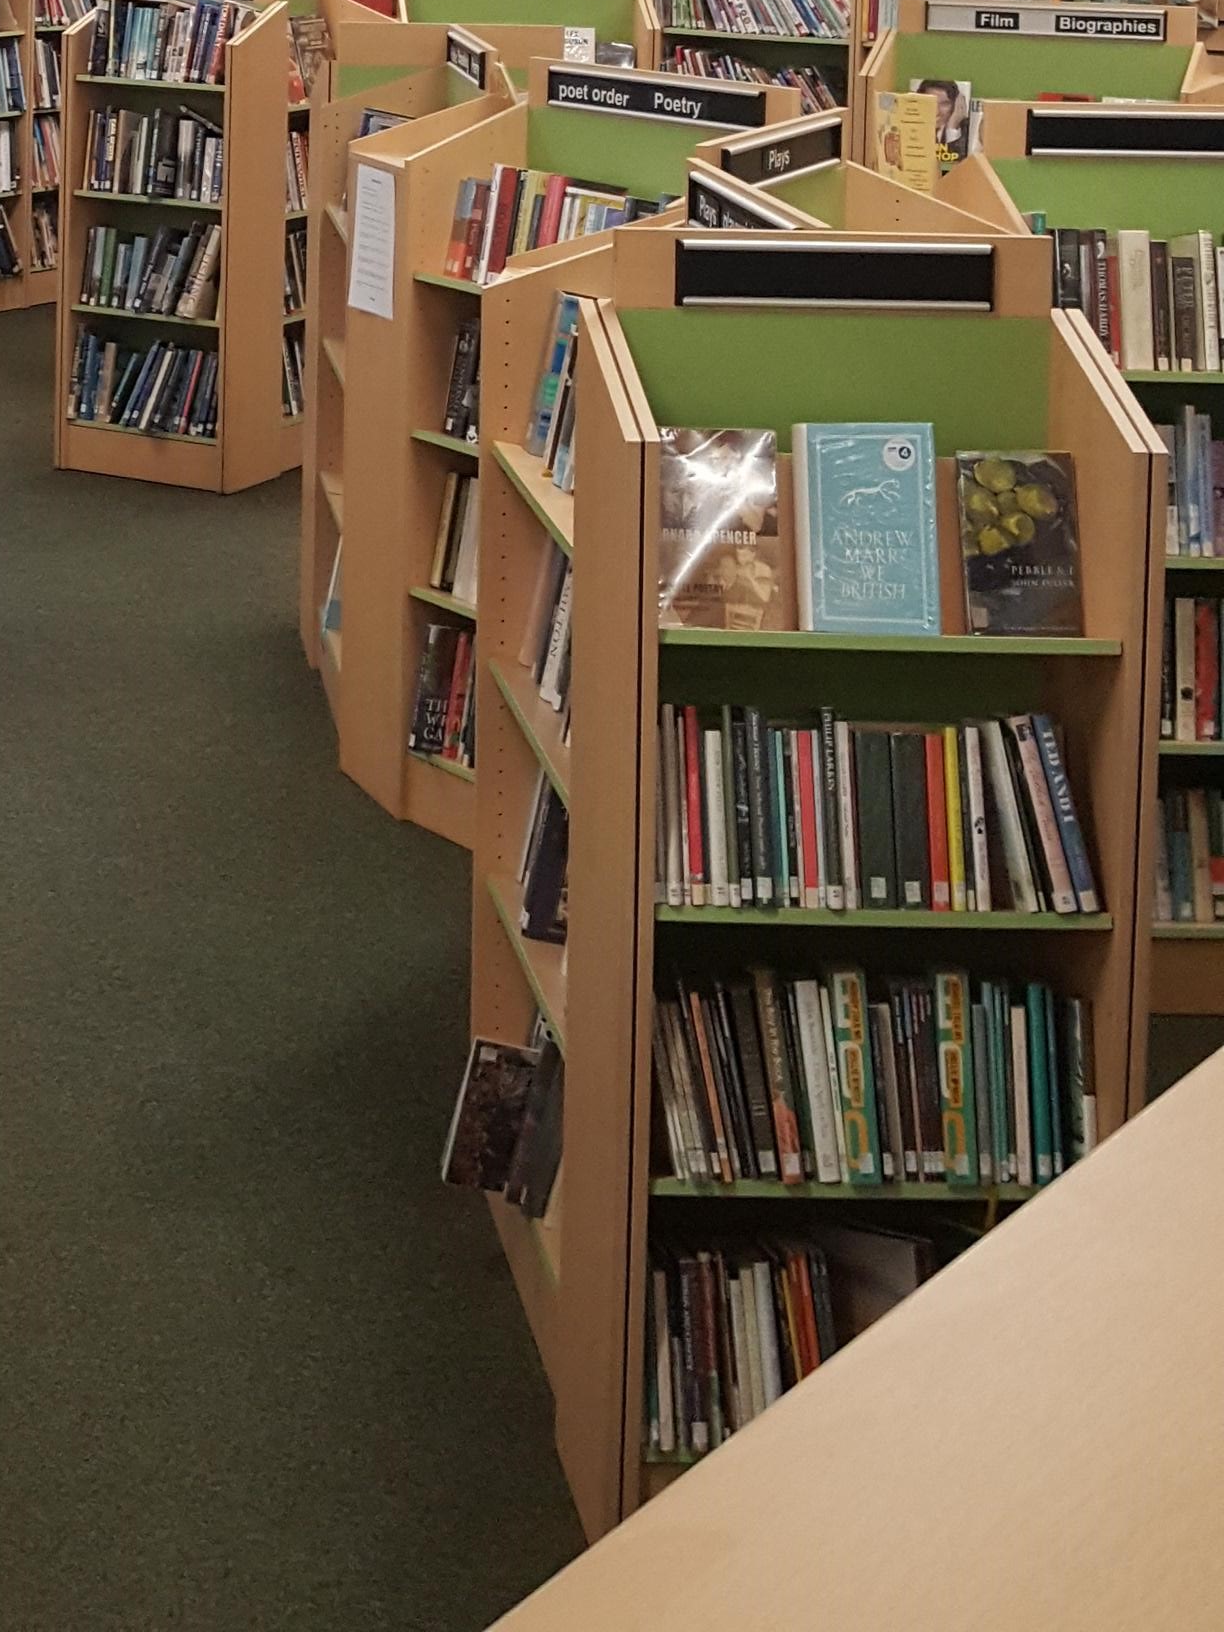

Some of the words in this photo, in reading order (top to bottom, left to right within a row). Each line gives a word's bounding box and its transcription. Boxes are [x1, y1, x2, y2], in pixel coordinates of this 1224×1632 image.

[980, 13, 1014, 28] Film
[1059, 16, 1157, 35] Biographies
[559, 83, 588, 100] poet
[592, 88, 630, 107] order
[654, 92, 702, 119] Poetry
[769, 149, 790, 170] Plays
[712, 529, 757, 545] PENCER
[832, 529, 914, 546] ANDREW
[845, 548, 900, 564] MARR
[861, 565, 883, 580] WE
[1011, 566, 1053, 576] PEBBLE
[841, 583, 906, 599] BRITISH
[823, 712, 834, 748] PHILIP
[825, 749, 837, 791] LARKIN
[1043, 728, 1061, 766] TED
[1052, 770, 1072, 811] AND
